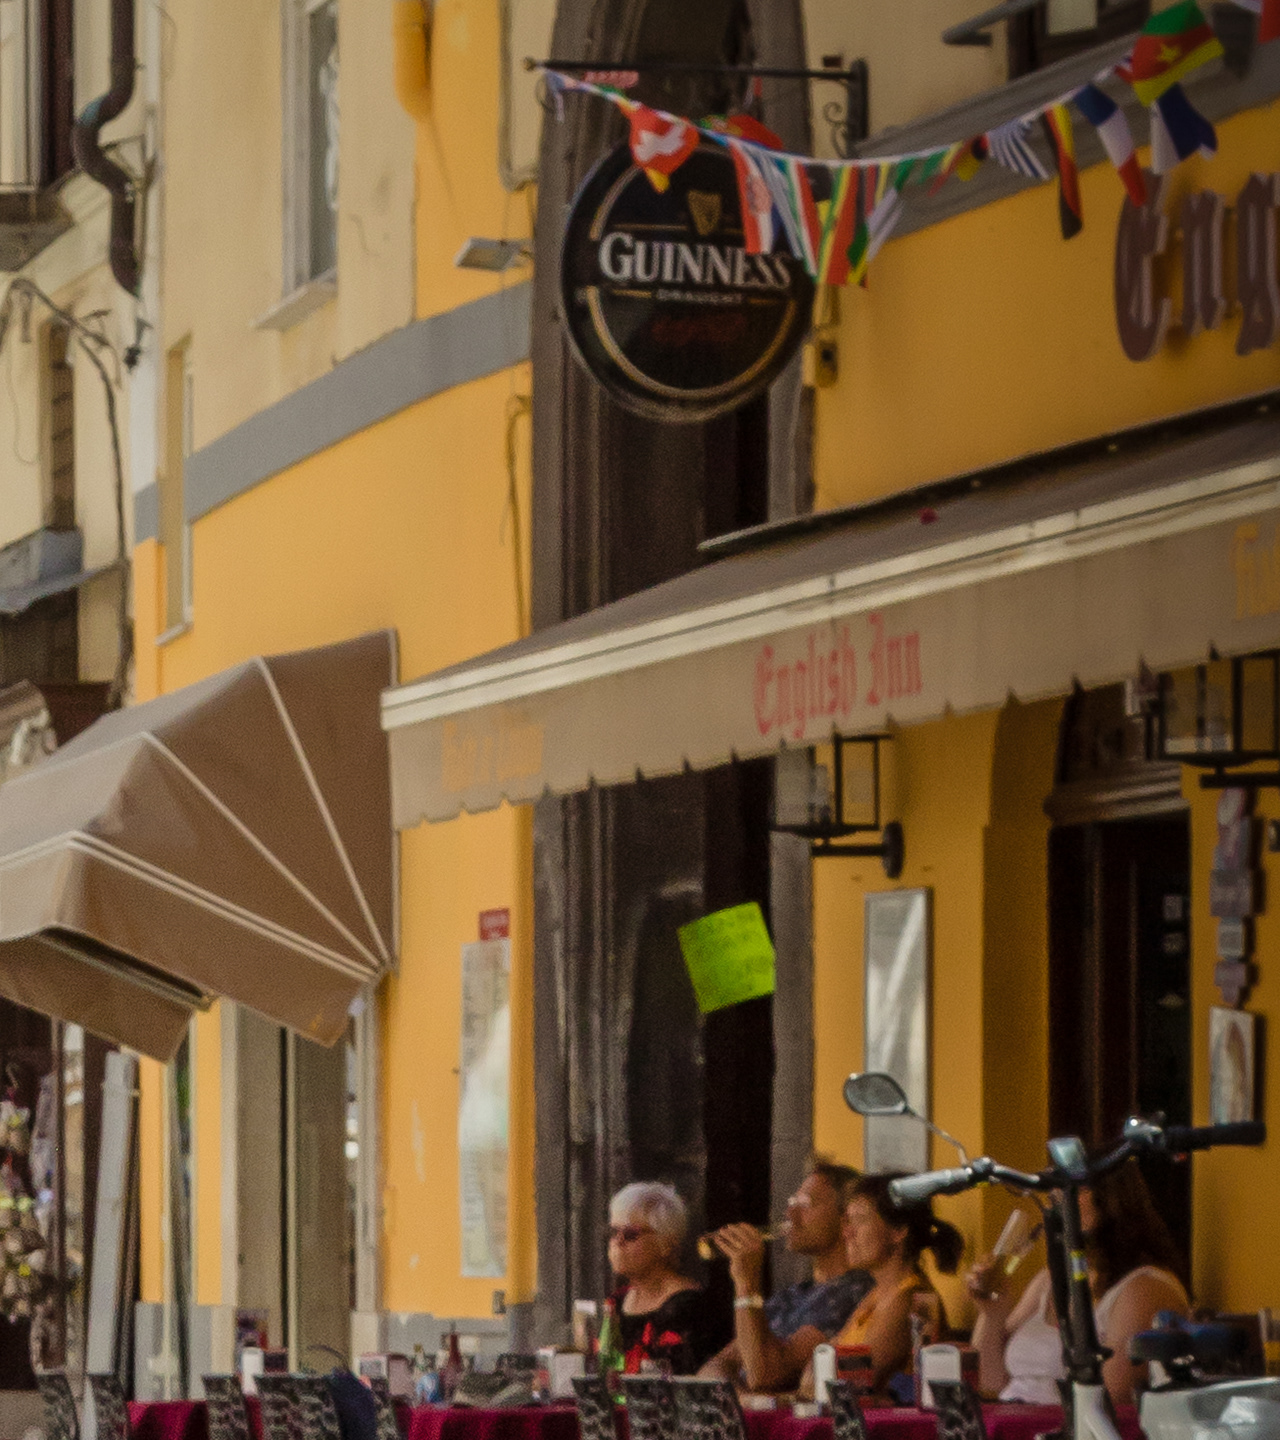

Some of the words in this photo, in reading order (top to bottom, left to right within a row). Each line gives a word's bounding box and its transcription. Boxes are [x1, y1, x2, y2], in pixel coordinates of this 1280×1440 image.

[598, 231, 791, 289] GUINNESS
[753, 625, 857, 740] English
[866, 613, 922, 706] Inn
